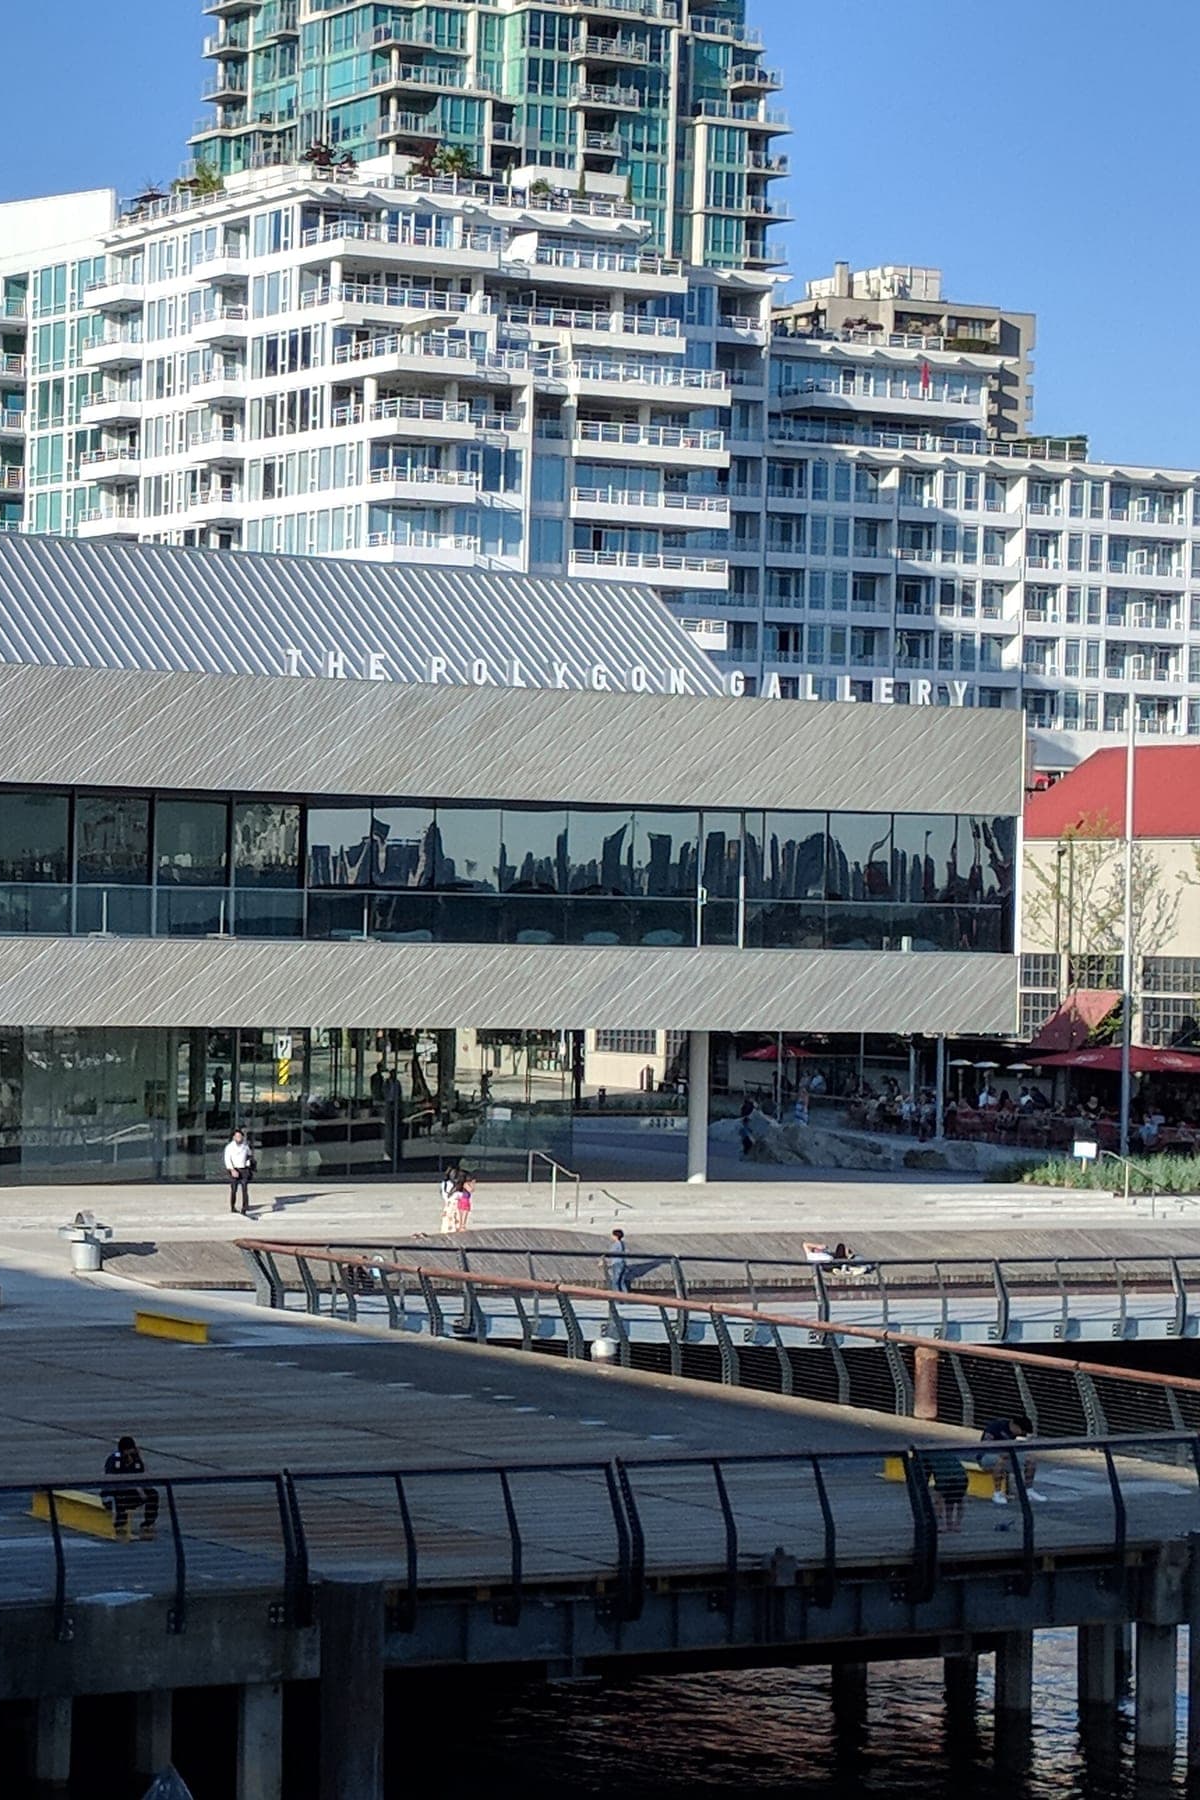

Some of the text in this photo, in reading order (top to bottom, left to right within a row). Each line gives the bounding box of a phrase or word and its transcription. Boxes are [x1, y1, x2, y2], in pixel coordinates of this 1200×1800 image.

[285, 649, 968, 707] THE POLYGON GALLERY
